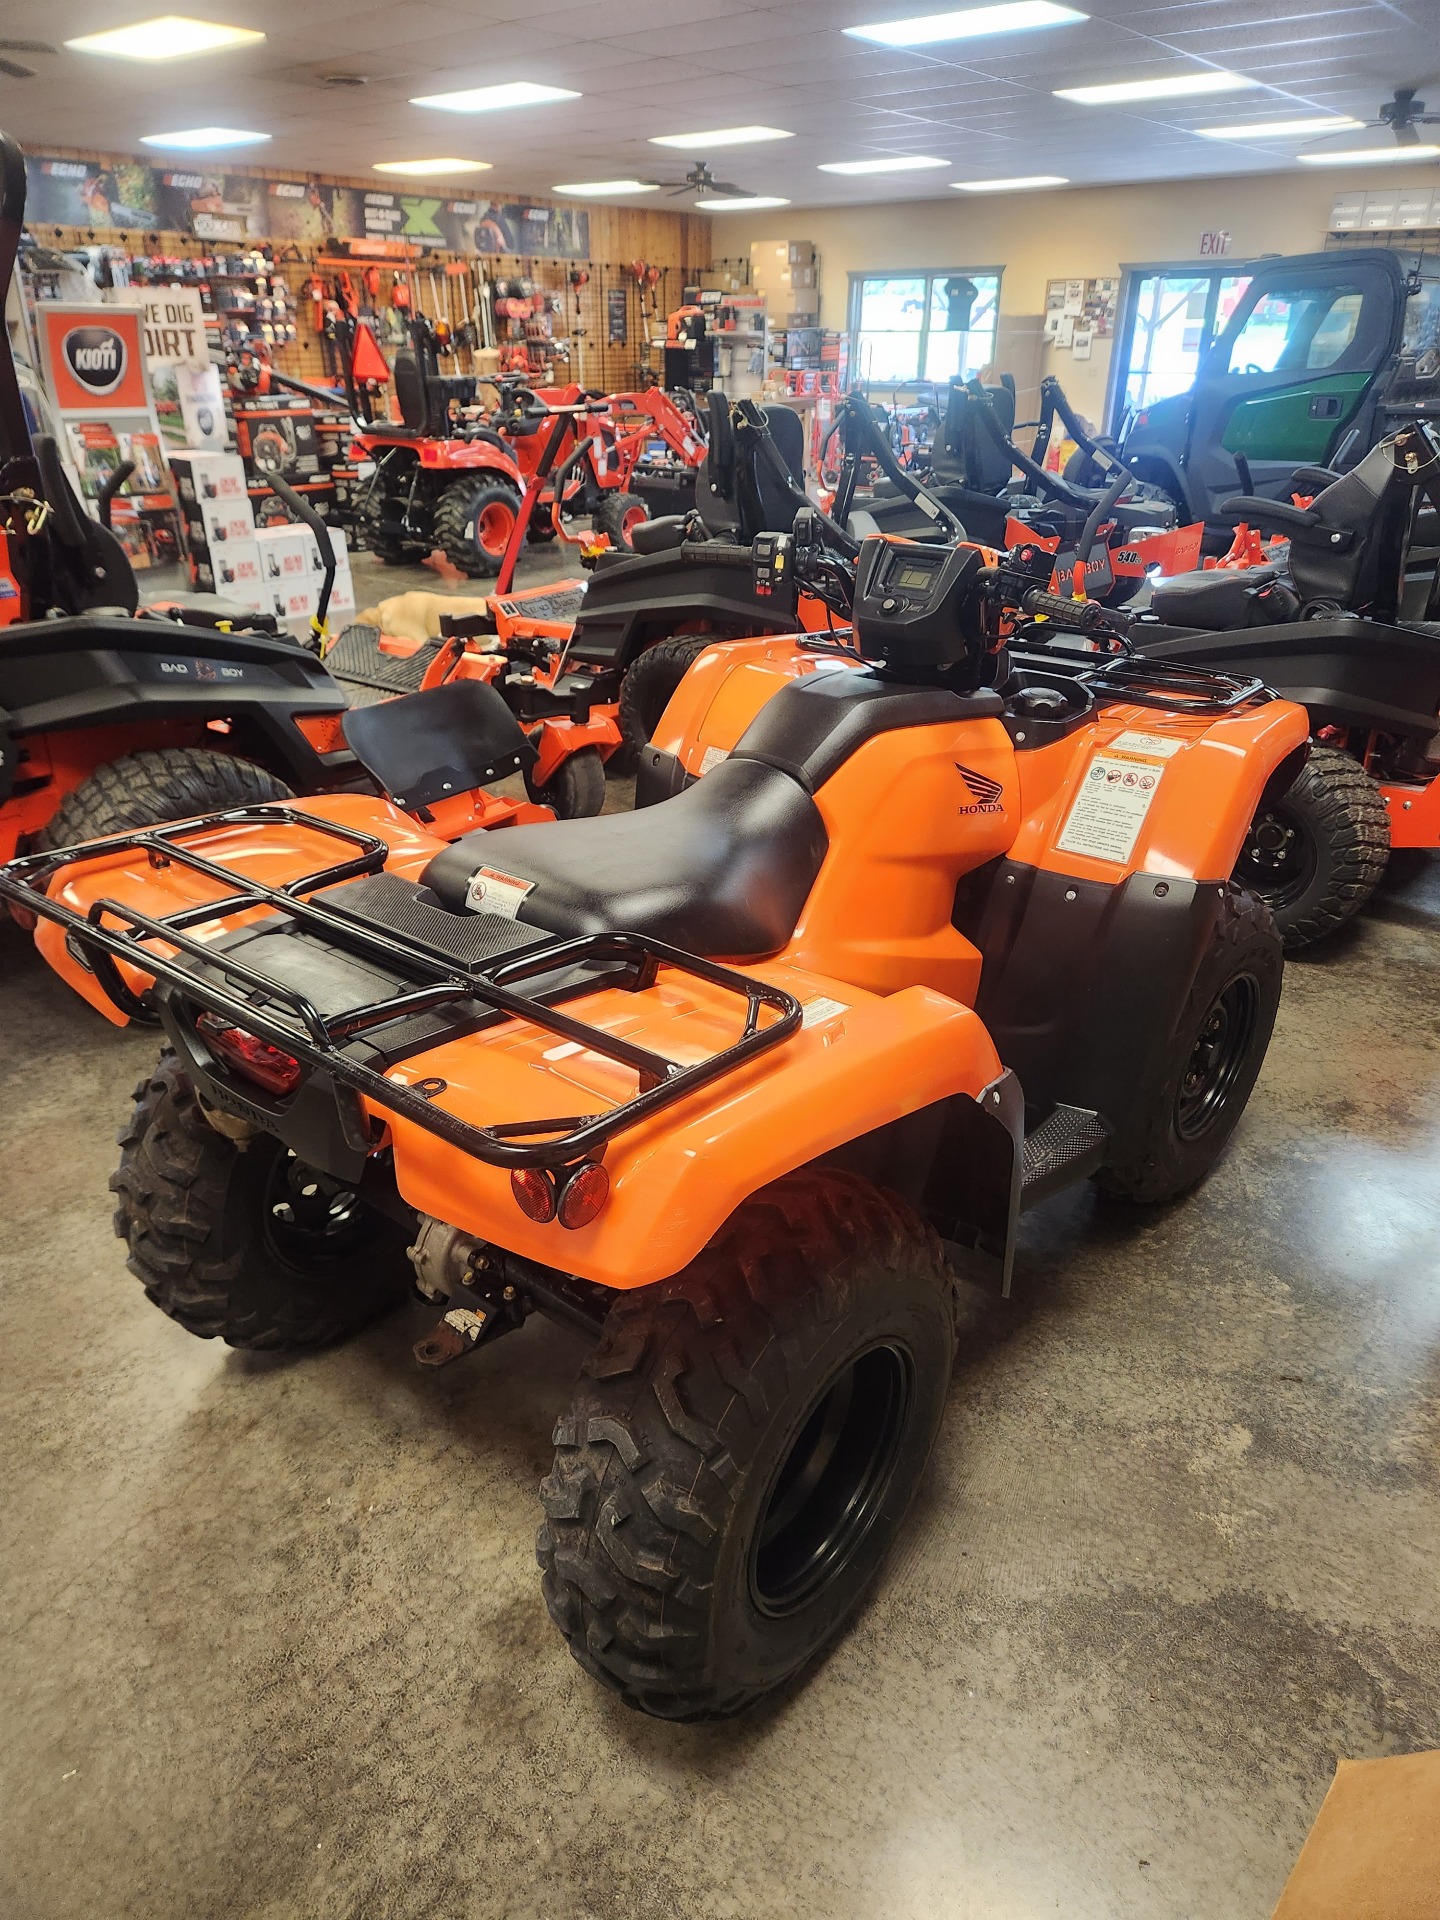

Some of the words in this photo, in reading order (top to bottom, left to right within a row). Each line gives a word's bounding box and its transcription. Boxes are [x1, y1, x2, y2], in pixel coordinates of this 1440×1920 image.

[51, 162, 87, 178] ECHO
[171, 173, 203, 189] ECHO
[1200, 232, 1229, 254] EXIT
[146, 303, 160, 323] E
[165, 303, 193, 323] DIG
[1085, 558, 1106, 575] BOY
[160, 662, 188, 674] BAD
[220, 667, 244, 678] BOY
[959, 803, 1005, 815] HONDA
